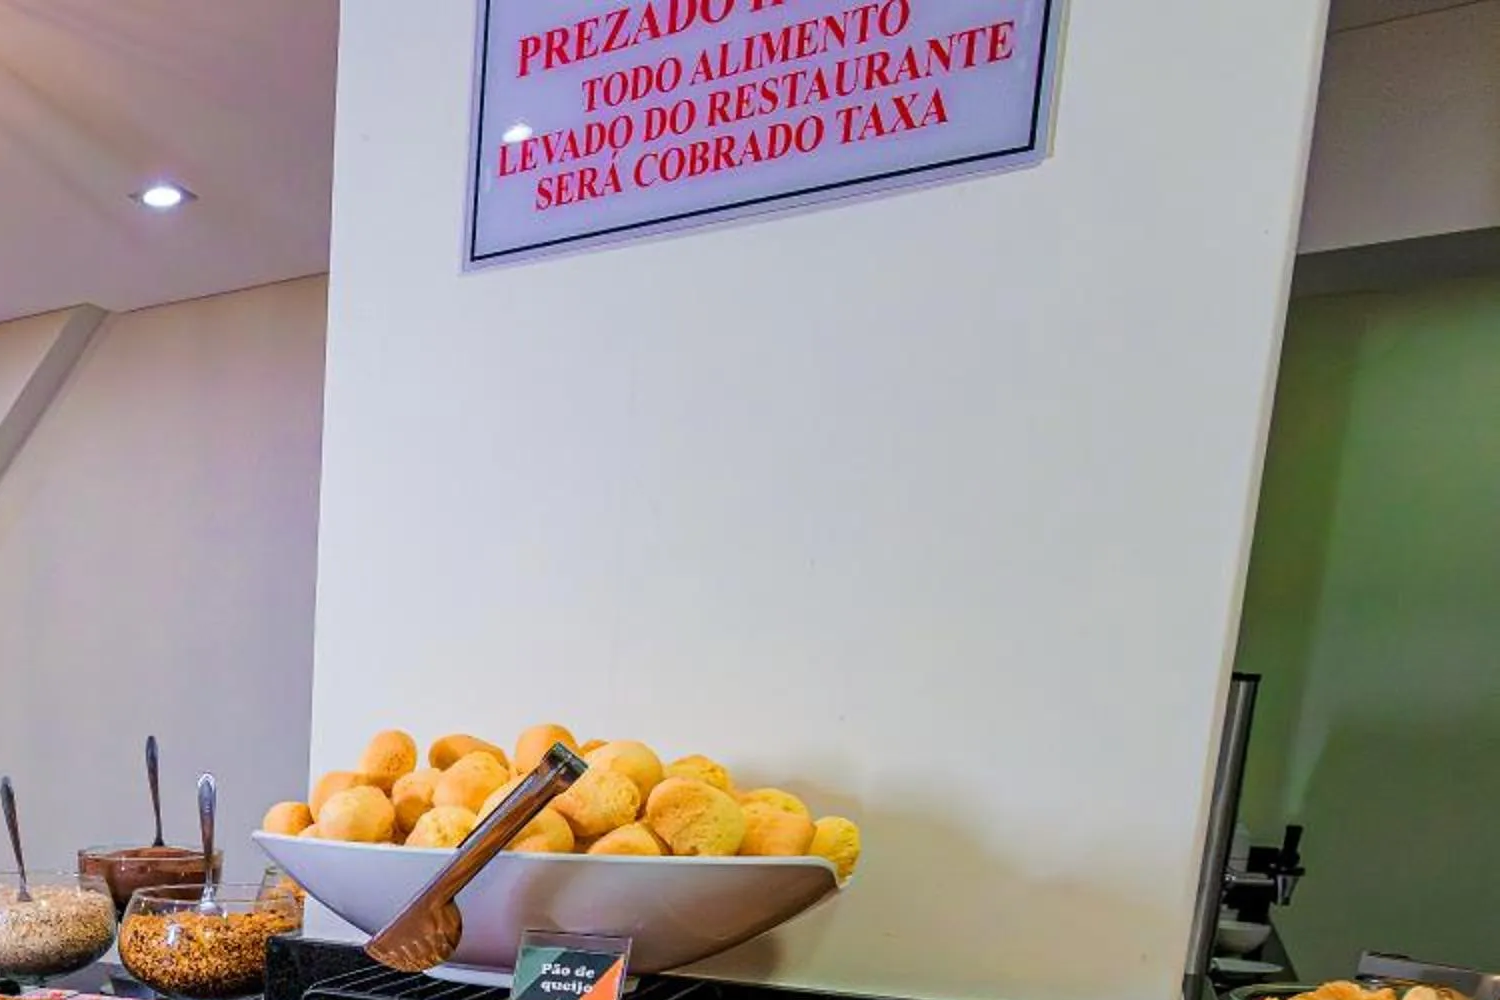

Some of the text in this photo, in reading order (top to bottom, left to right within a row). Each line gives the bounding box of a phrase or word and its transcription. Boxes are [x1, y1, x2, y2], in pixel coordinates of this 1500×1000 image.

[516, 0, 735, 78] PREZADO
[582, 0, 910, 112] TODO ALIMENTO
[499, 20, 1014, 177] LEVADO DO RESTAURANTE
[536, 88, 947, 210] SERÁ COBRADO TAXA
[540, 979, 594, 995] queijo
[541, 962, 595, 978] Pão de
